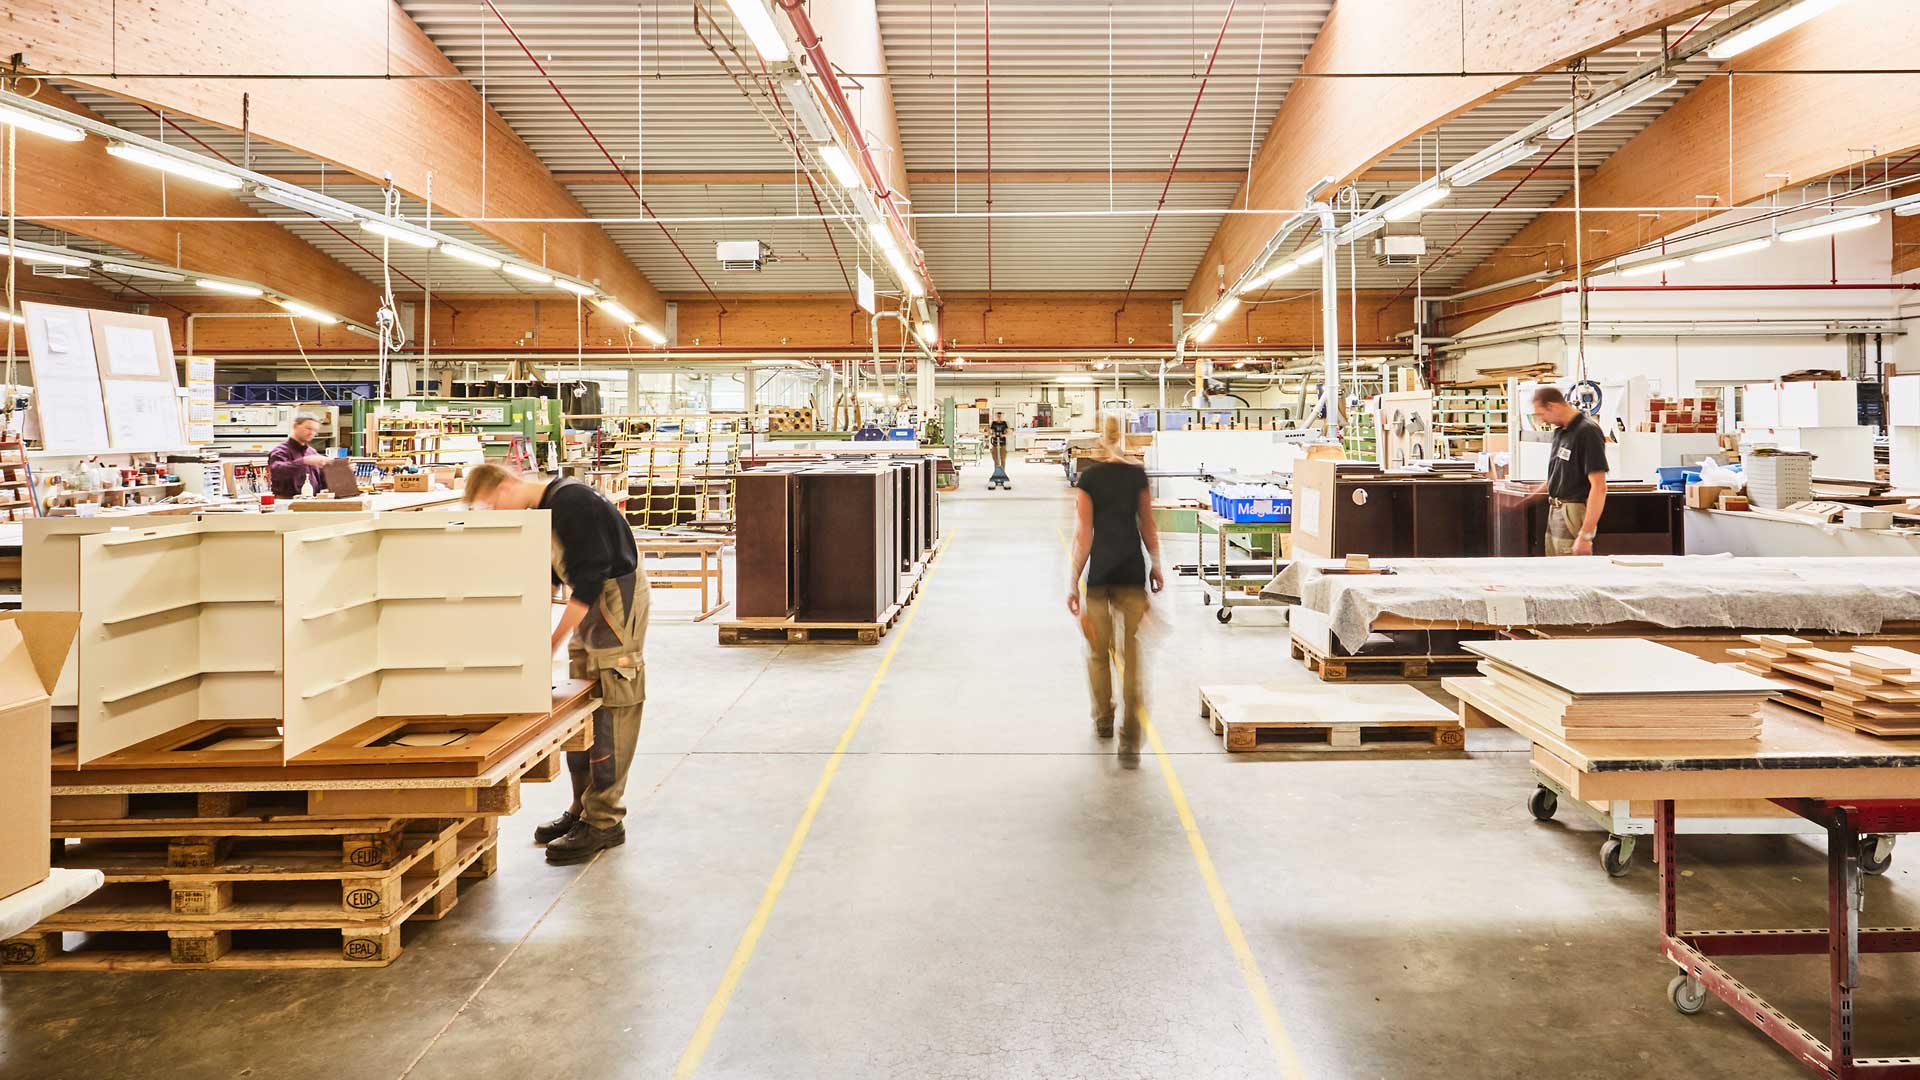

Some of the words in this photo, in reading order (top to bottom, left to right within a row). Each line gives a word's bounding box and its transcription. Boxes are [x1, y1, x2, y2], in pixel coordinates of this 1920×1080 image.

[1238, 503, 1291, 518] Mazin
[357, 850, 378, 864] EUR
[353, 892, 373, 906] EUR
[349, 943, 372, 955] EPAL
